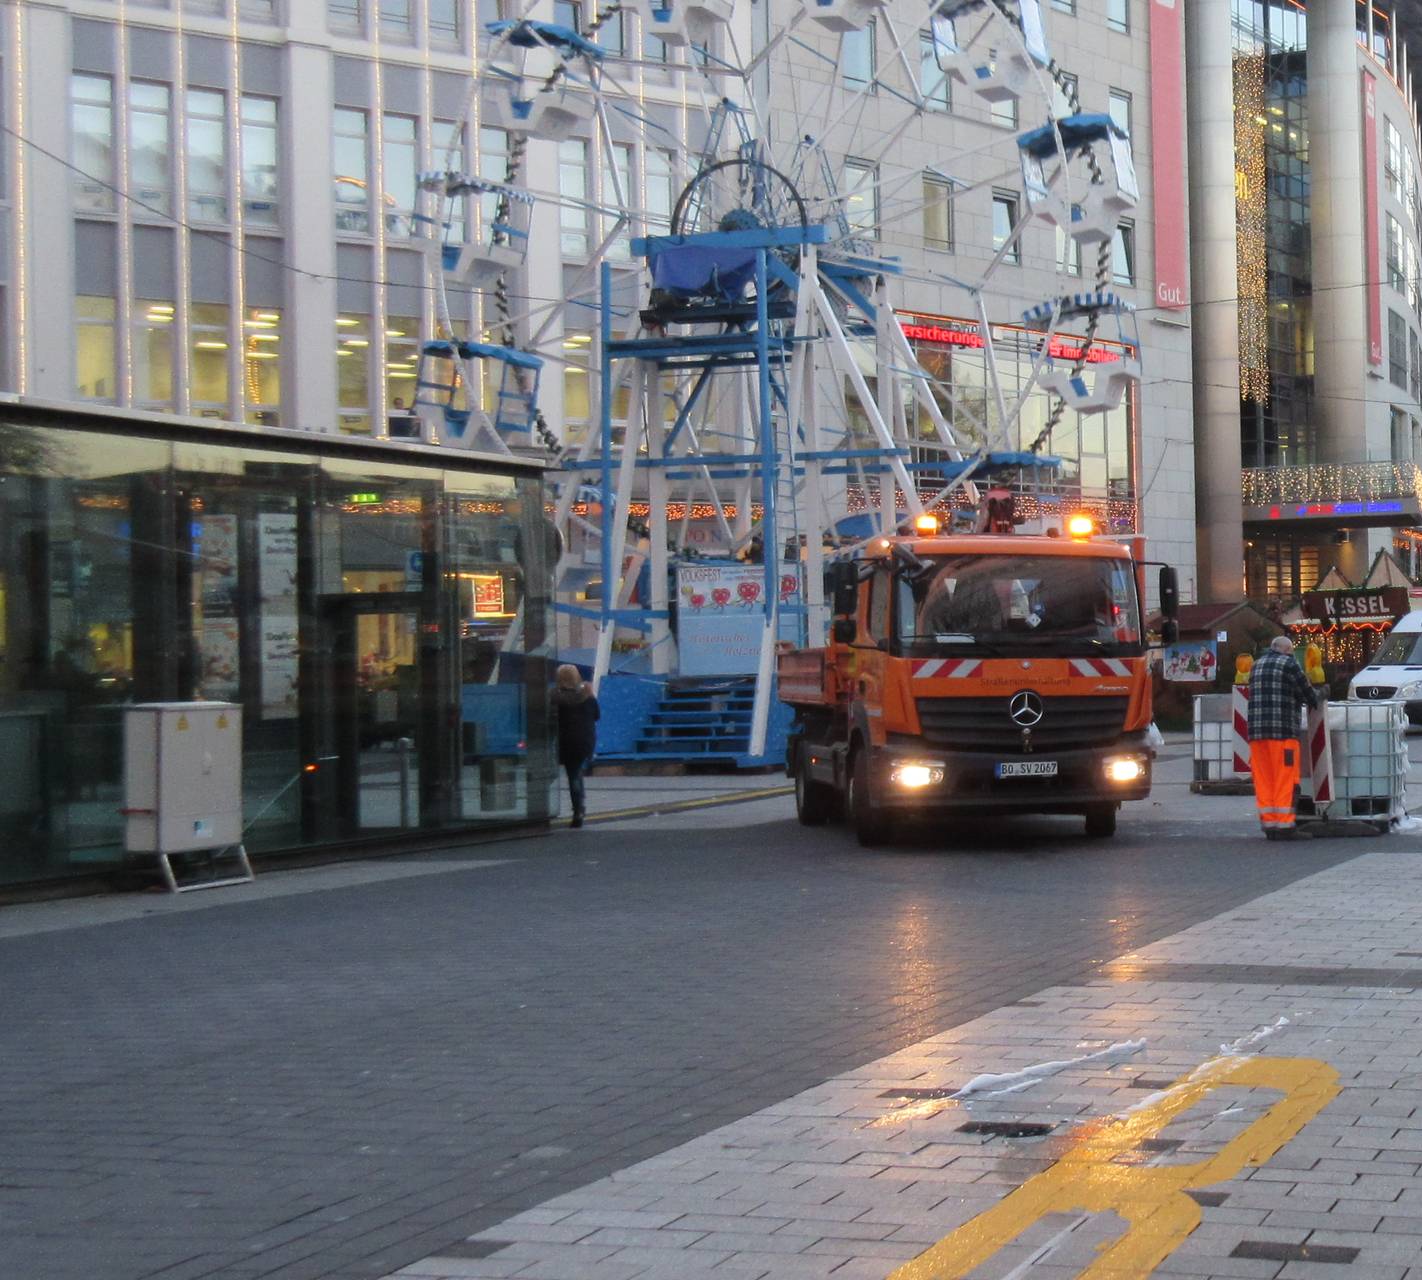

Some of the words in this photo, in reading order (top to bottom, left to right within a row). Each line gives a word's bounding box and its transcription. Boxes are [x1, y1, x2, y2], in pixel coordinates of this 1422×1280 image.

[1158, 282, 1184, 304] Gut.
[680, 567, 721, 583] VOLKSFEST
[1001, 763, 1014, 775] BO
[1020, 762, 1033, 774] SV
[1034, 762, 1057, 773] 2067
